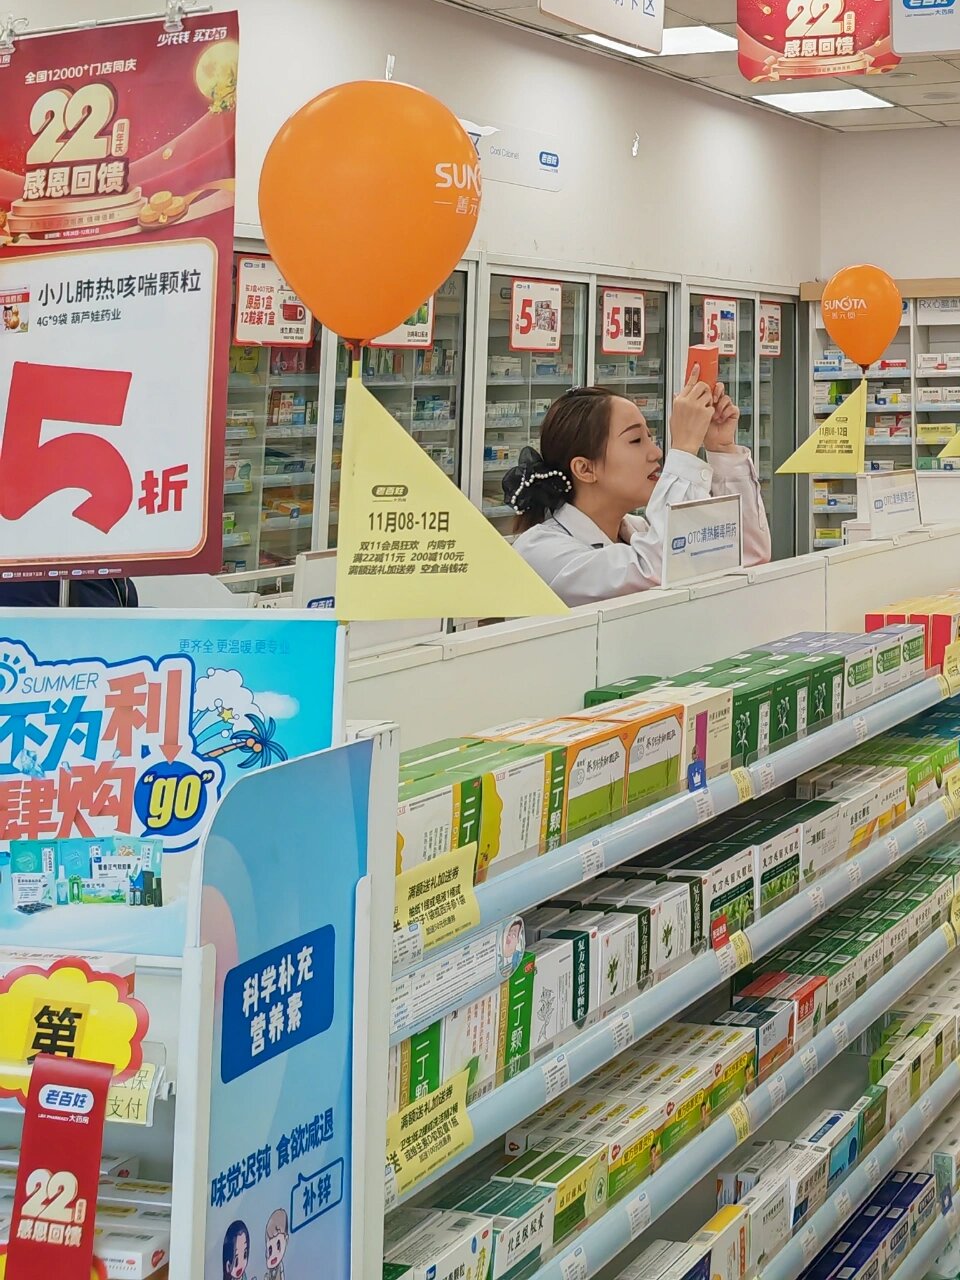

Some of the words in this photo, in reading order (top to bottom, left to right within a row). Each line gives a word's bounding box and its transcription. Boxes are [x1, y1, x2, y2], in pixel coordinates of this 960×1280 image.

[784, 36, 855, 58] 感恩回馈
[26, 82, 117, 166] 22
[23, 160, 126, 202] 感恩回馈
[37, 269, 202, 308] 小儿肺热咳喘颗粒
[70, 308, 122, 326] 葫芦娃药业
[519, 298, 533, 335] 5
[609, 306, 621, 340] 5
[709, 314, 718, 343] 5
[138, 463, 189, 516] 折
[368, 510, 450, 534] 11月08-12日
[352, 552, 406, 563] 满22减11元
[410, 551, 465, 562] 200减100元
[359, 540, 420, 551] 双11会员狂欢
[427, 539, 457, 550] 内购节
[348, 564, 416, 576] 满额送礼加送券
[419, 563, 469, 574] 空盒当钱花
[178, 638, 214, 654] 更齐全
[216, 638, 252, 655] 更温暖
[253, 639, 292, 657] 更专业
[21, 672, 99, 695] SUMMER
[242, 945, 314, 1018] 科学补充
[27, 1004, 83, 1064] 第
[250, 991, 304, 1058] 营养素
[509, 977, 525, 1077] 二丁颗粒
[45, 1088, 90, 1108] 老百姓
[210, 1144, 272, 1208] 味觉迟钝
[276, 1107, 335, 1167] 食欲减退
[21, 1168, 79, 1221] 22
[302, 1173, 332, 1216] 补锌
[16, 1218, 83, 1248] 感恩回馈
